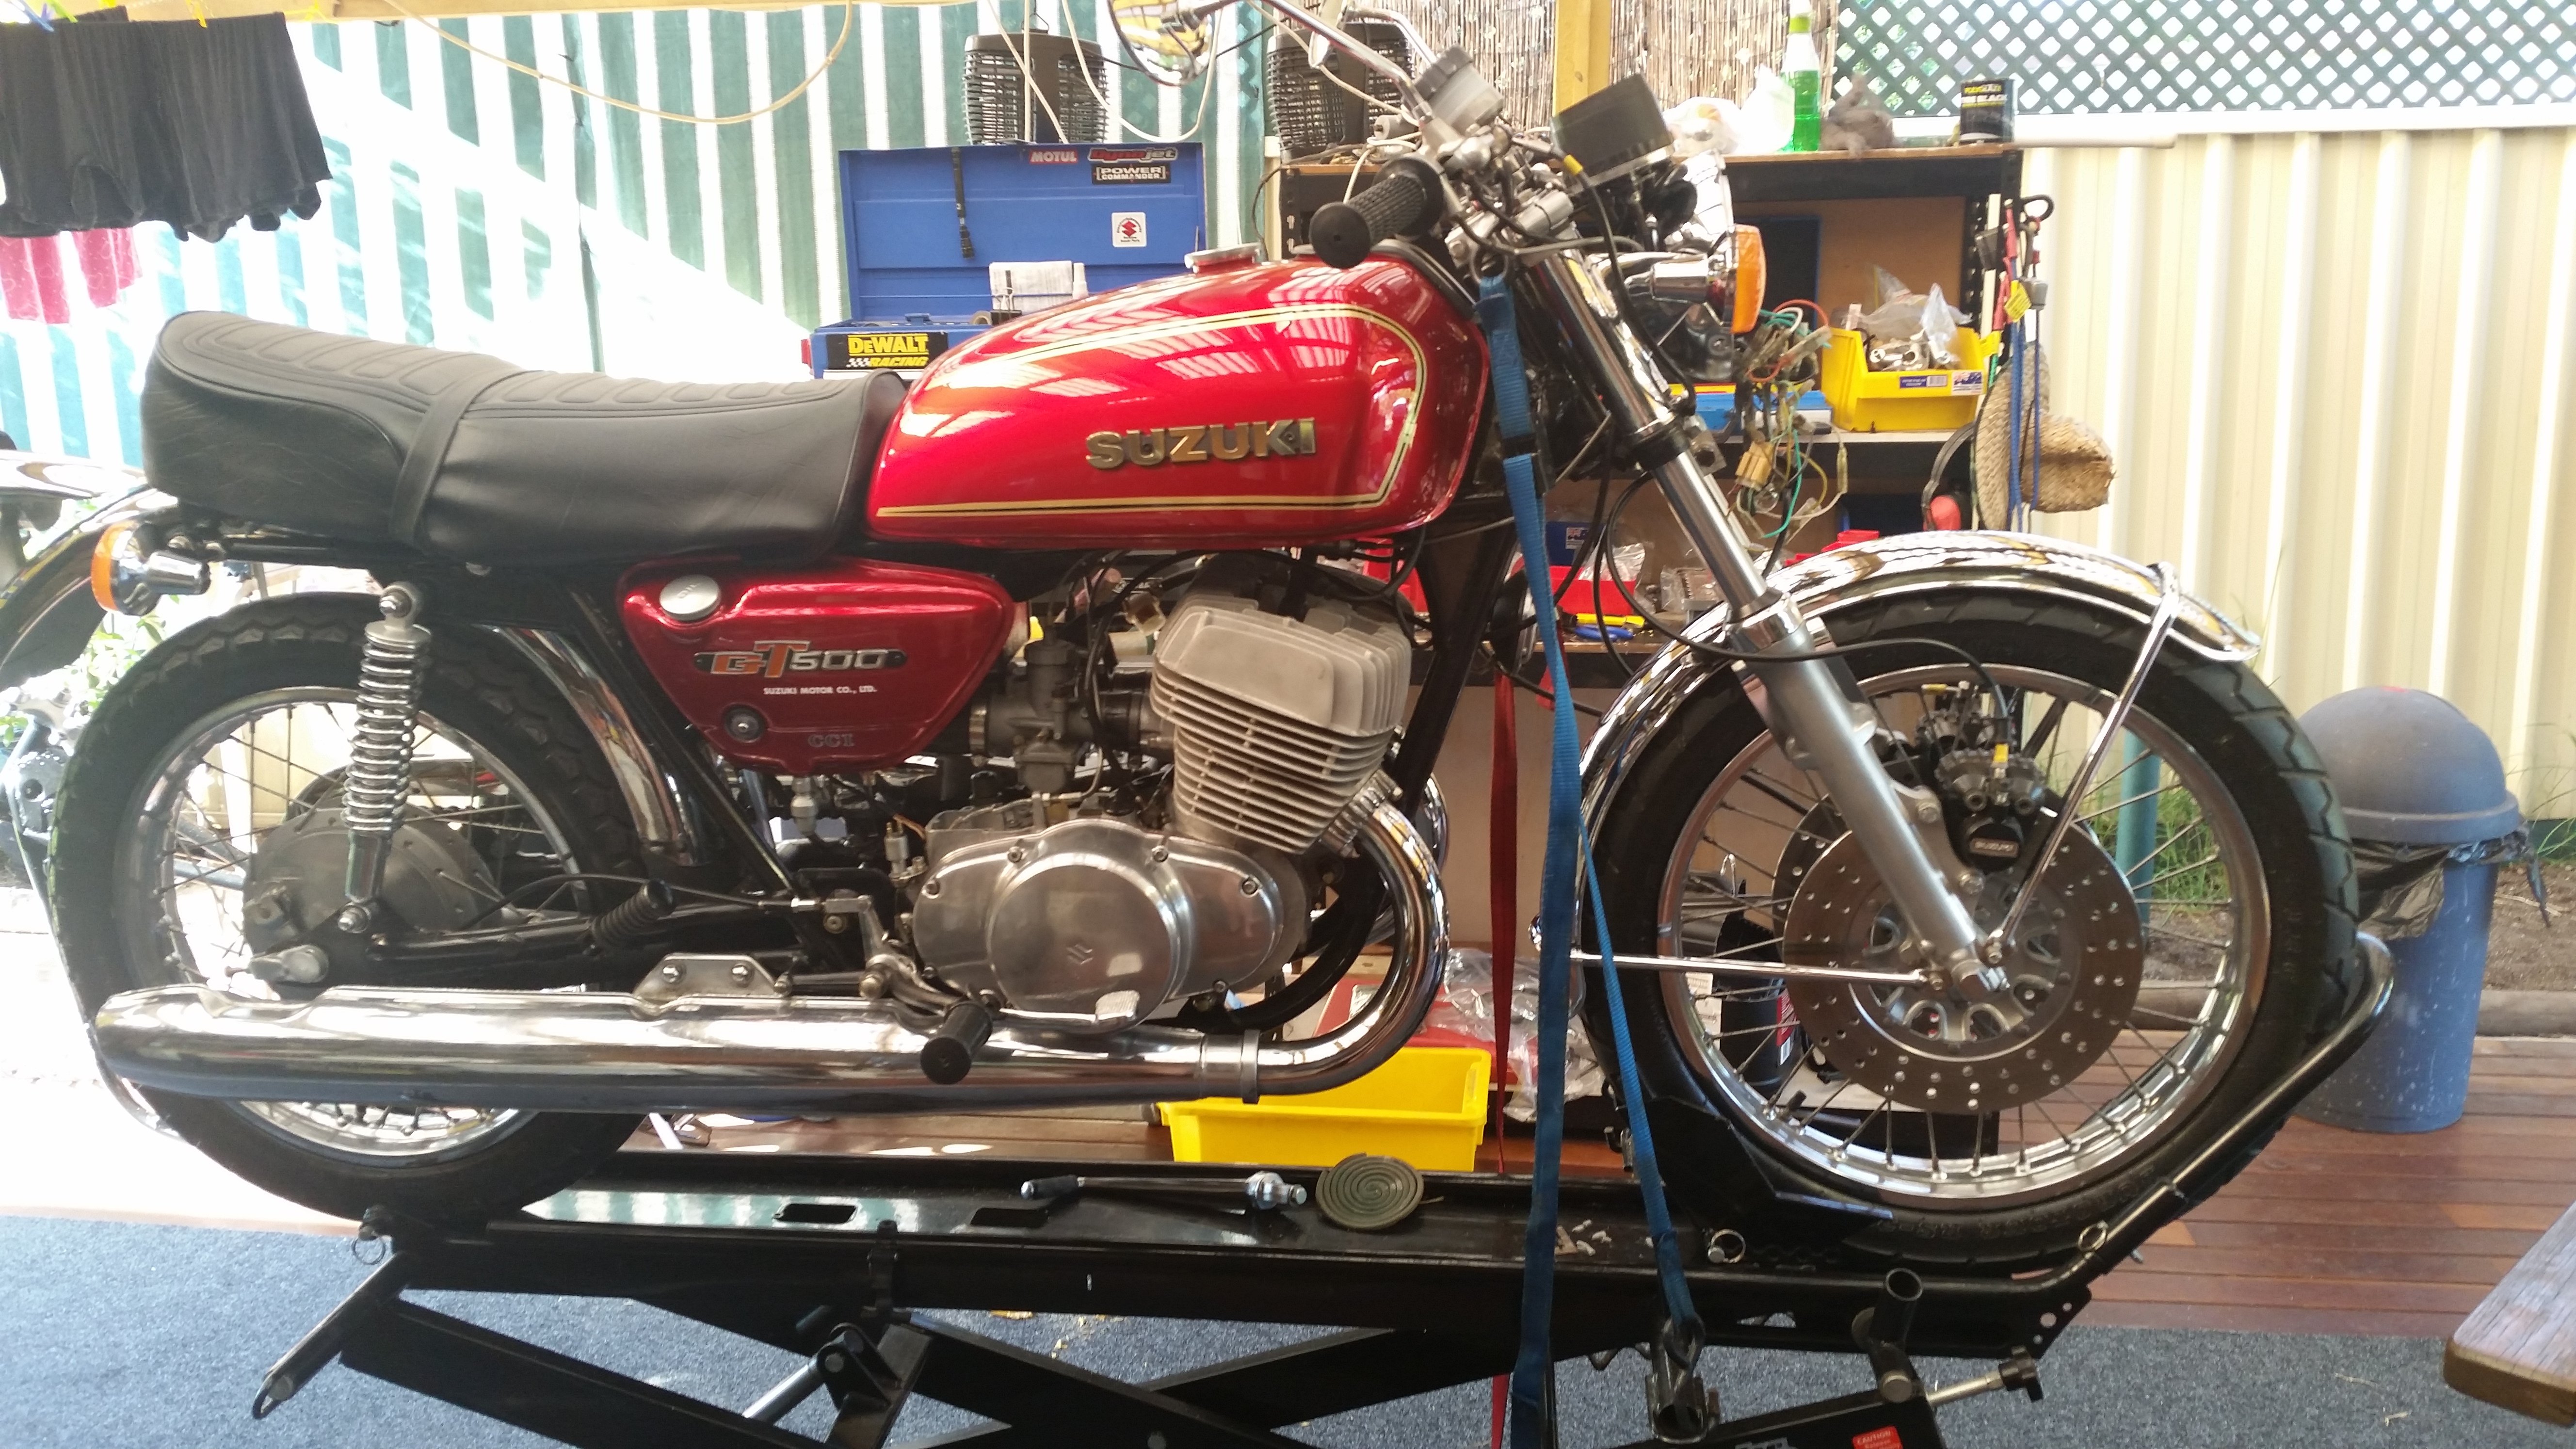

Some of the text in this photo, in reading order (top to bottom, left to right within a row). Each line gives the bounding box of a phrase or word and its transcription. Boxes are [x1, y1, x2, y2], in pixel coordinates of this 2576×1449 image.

[1031, 151, 1078, 162] MOTUL
[1100, 166, 1162, 175] POWER
[869, 356, 929, 367] RACING
[1085, 417, 1317, 469] SUZUKI
[763, 687, 798, 695] SUZUKI
[800, 686, 834, 694] MOTOR
[859, 685, 878, 693] LTD.
